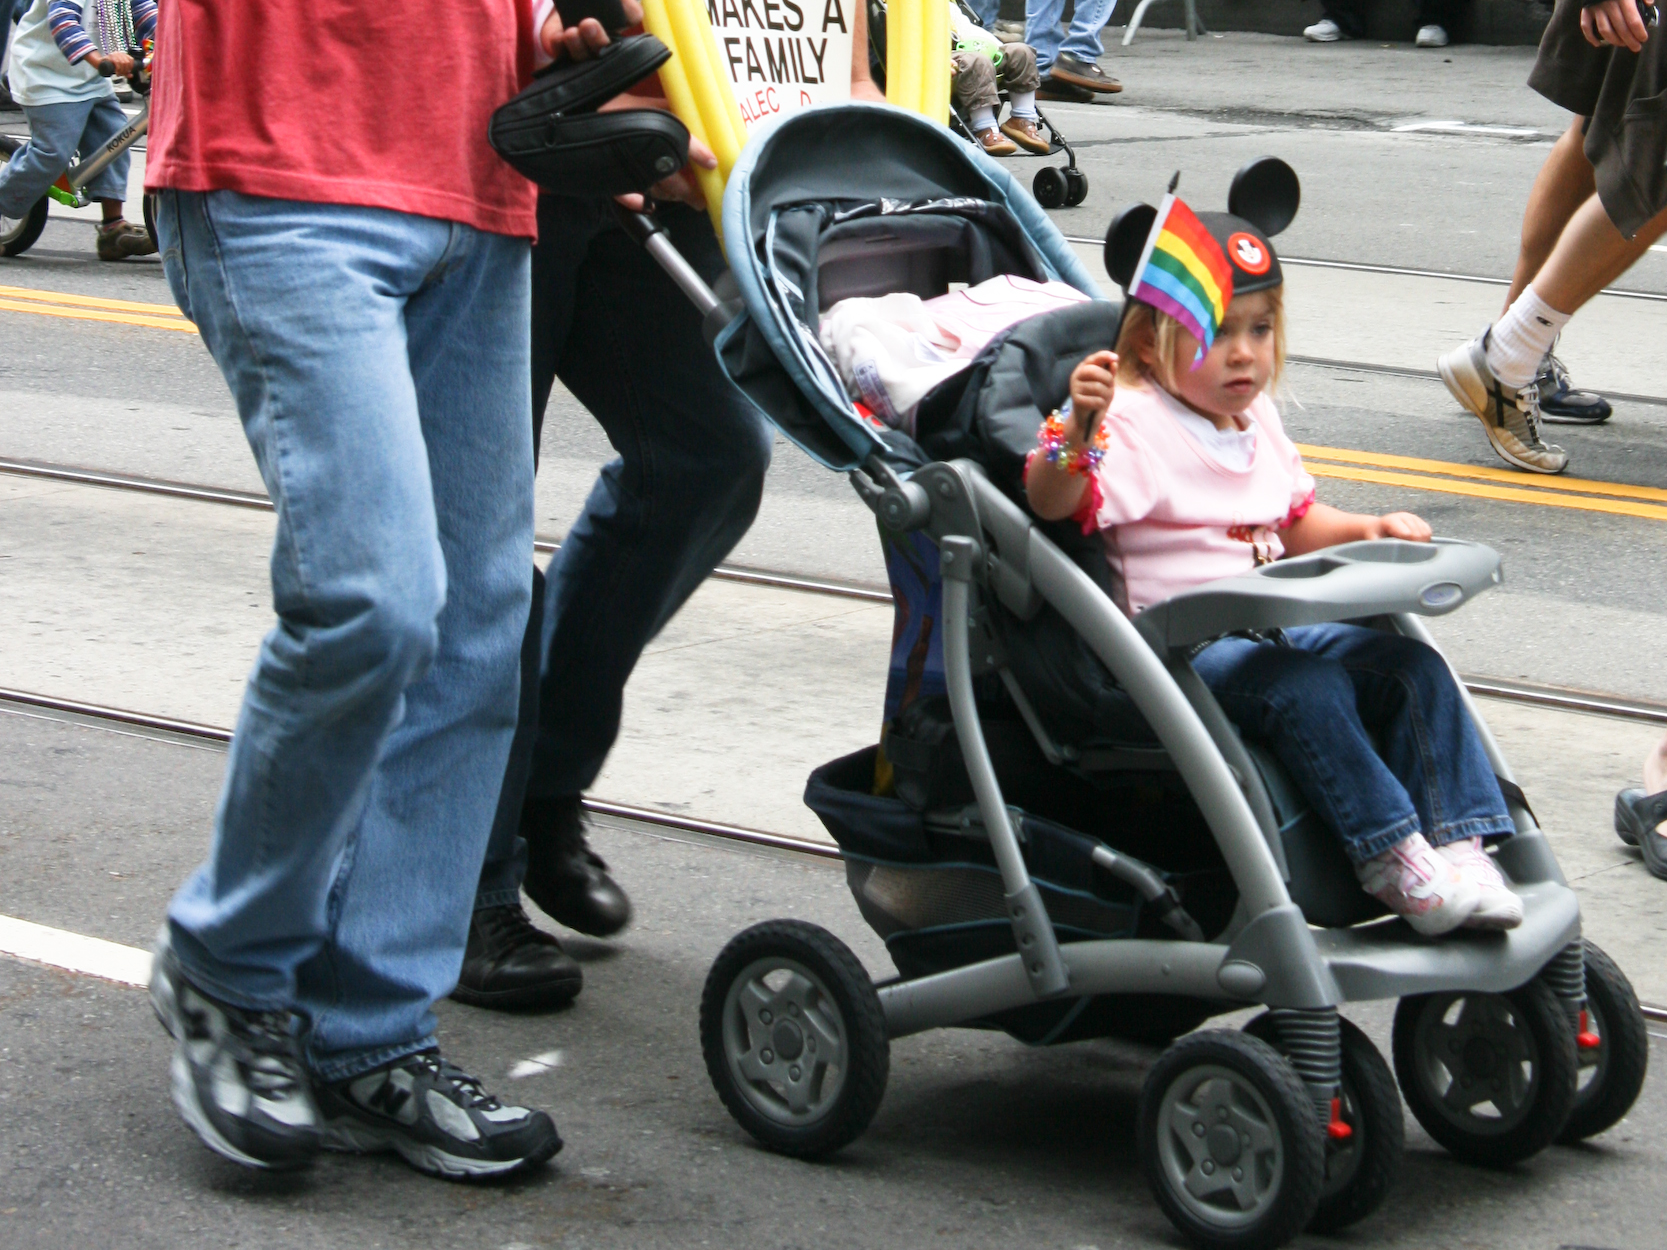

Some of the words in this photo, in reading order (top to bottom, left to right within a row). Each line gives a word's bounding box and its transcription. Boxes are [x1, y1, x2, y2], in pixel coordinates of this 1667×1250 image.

[723, 36, 828, 84] FAMILY
[740, 87, 780, 128] ALEC
[106, 126, 136, 153] KOKUA
